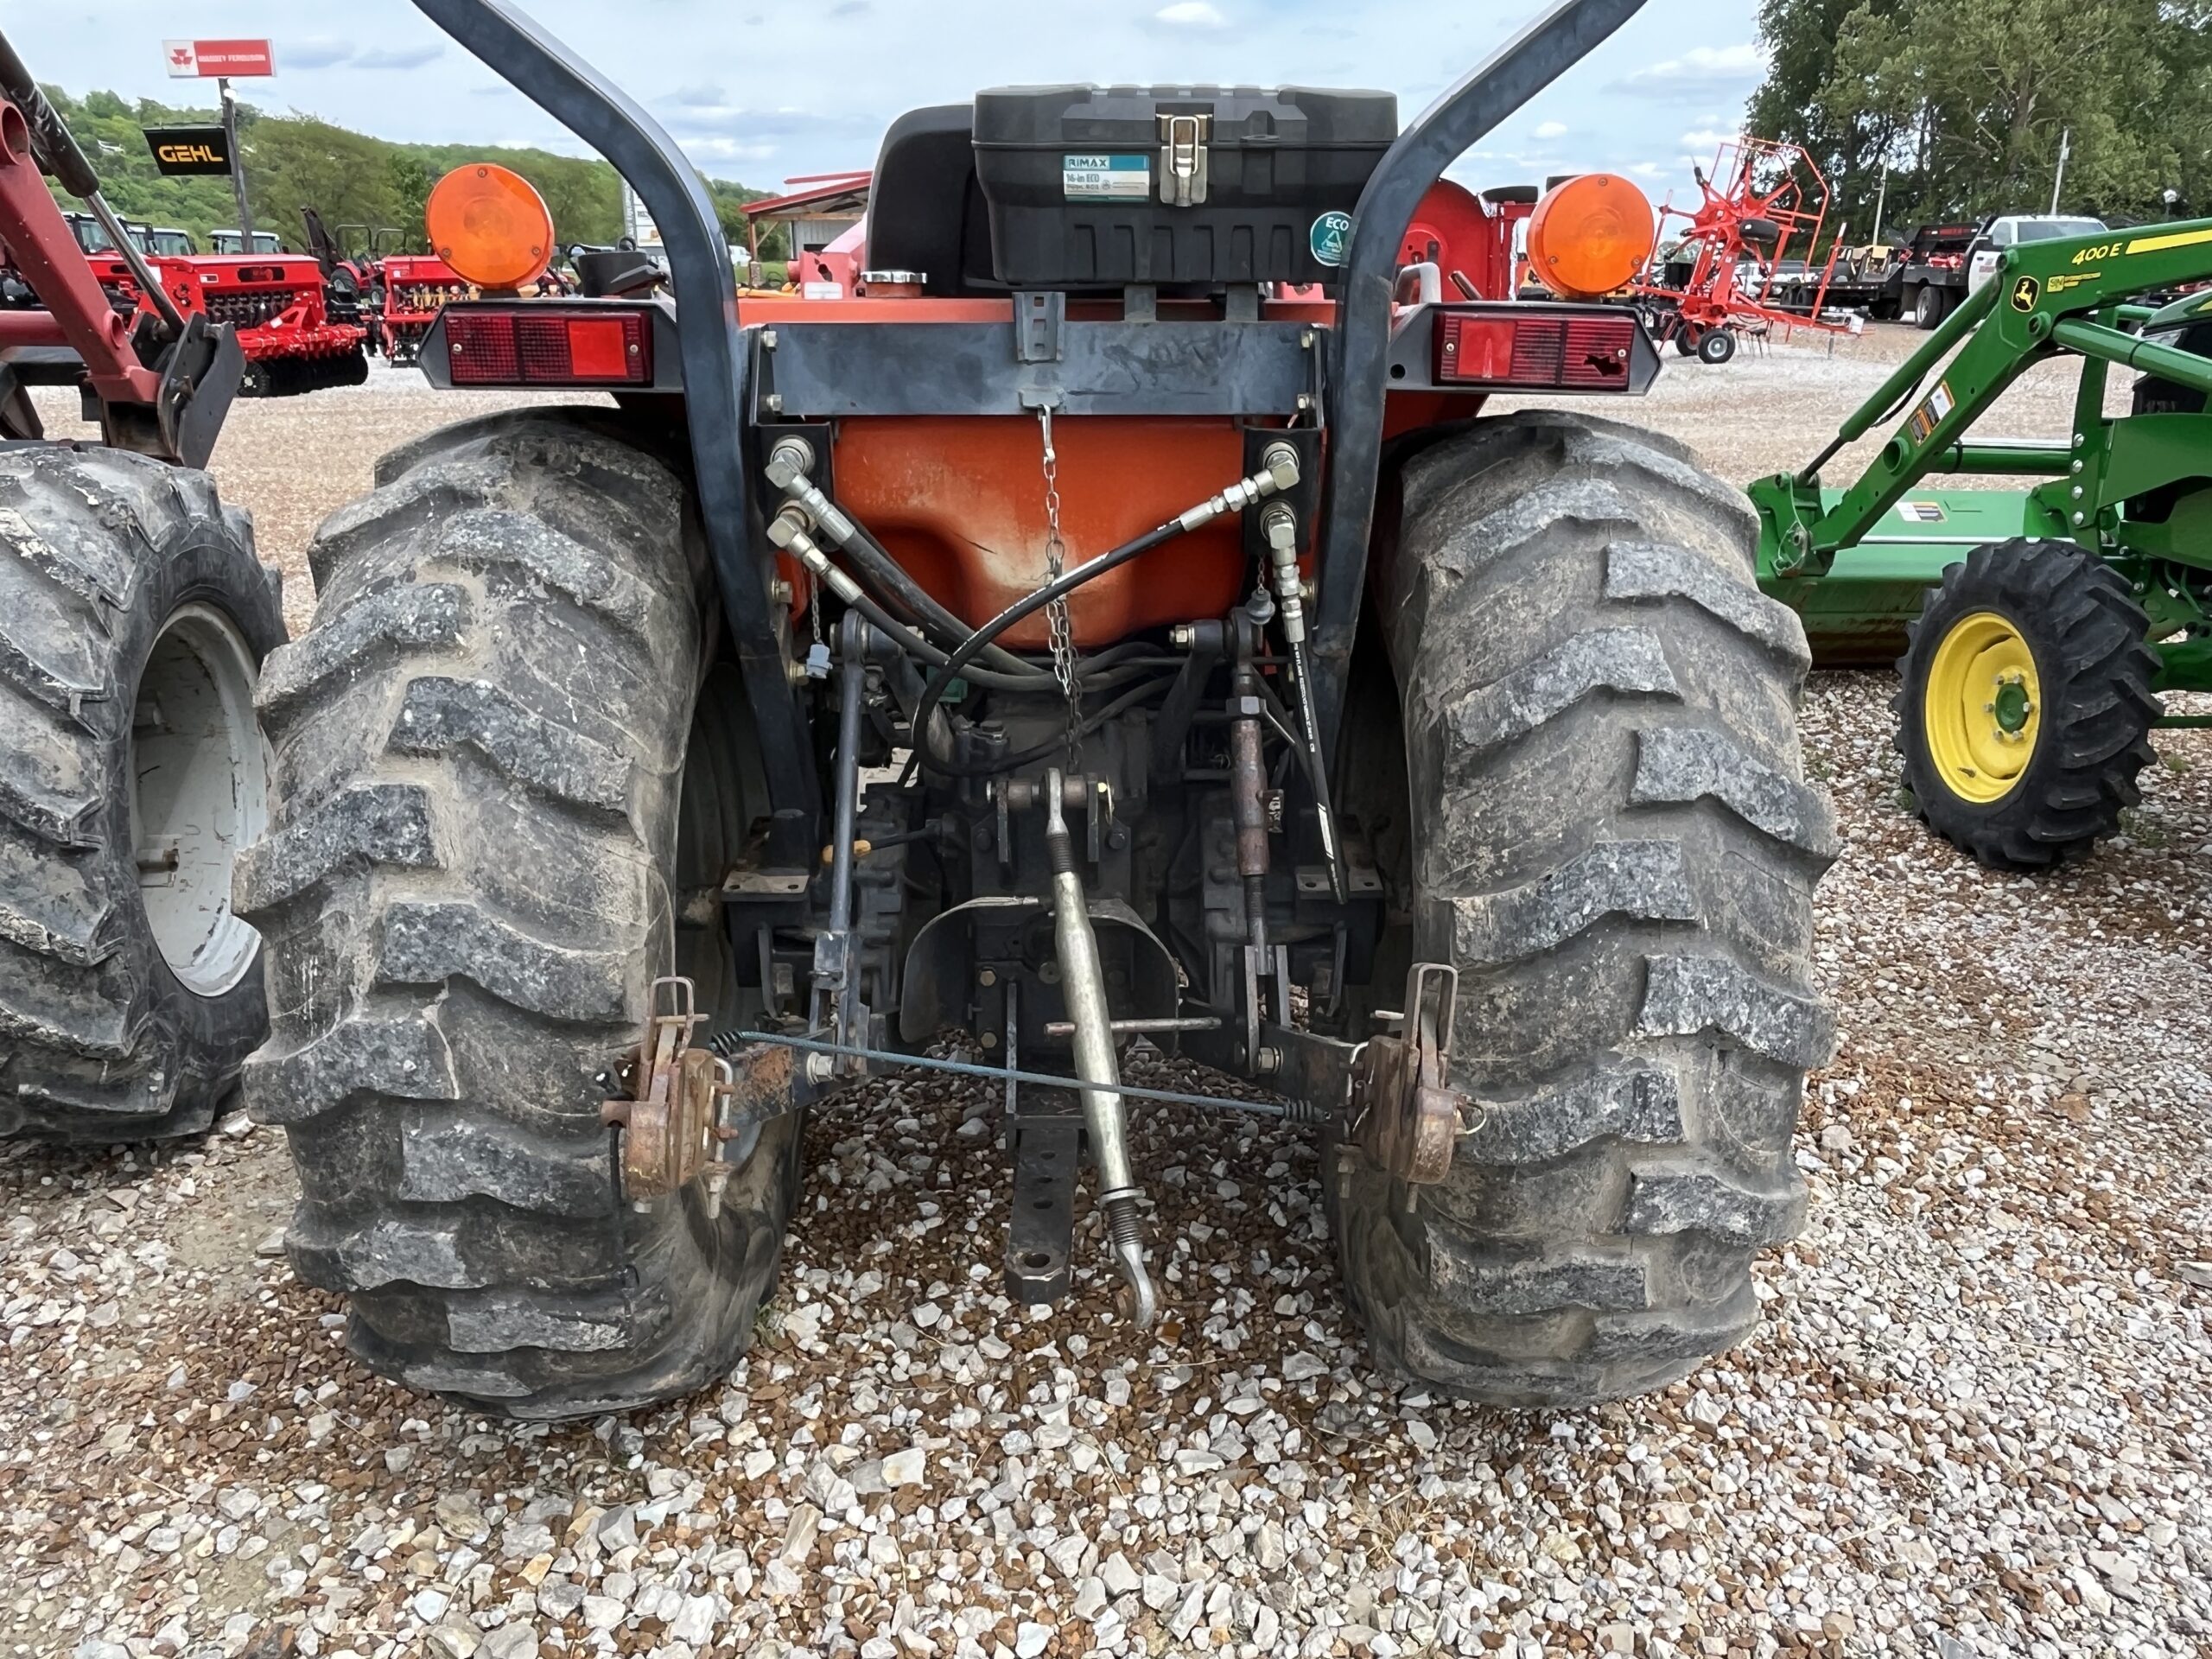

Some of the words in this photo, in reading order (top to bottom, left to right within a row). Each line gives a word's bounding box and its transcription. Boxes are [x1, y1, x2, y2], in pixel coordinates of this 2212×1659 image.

[158, 145, 224, 162] GEHL
[1068, 158, 1107, 168] RIMAX
[1325, 216, 1350, 232] ECO
